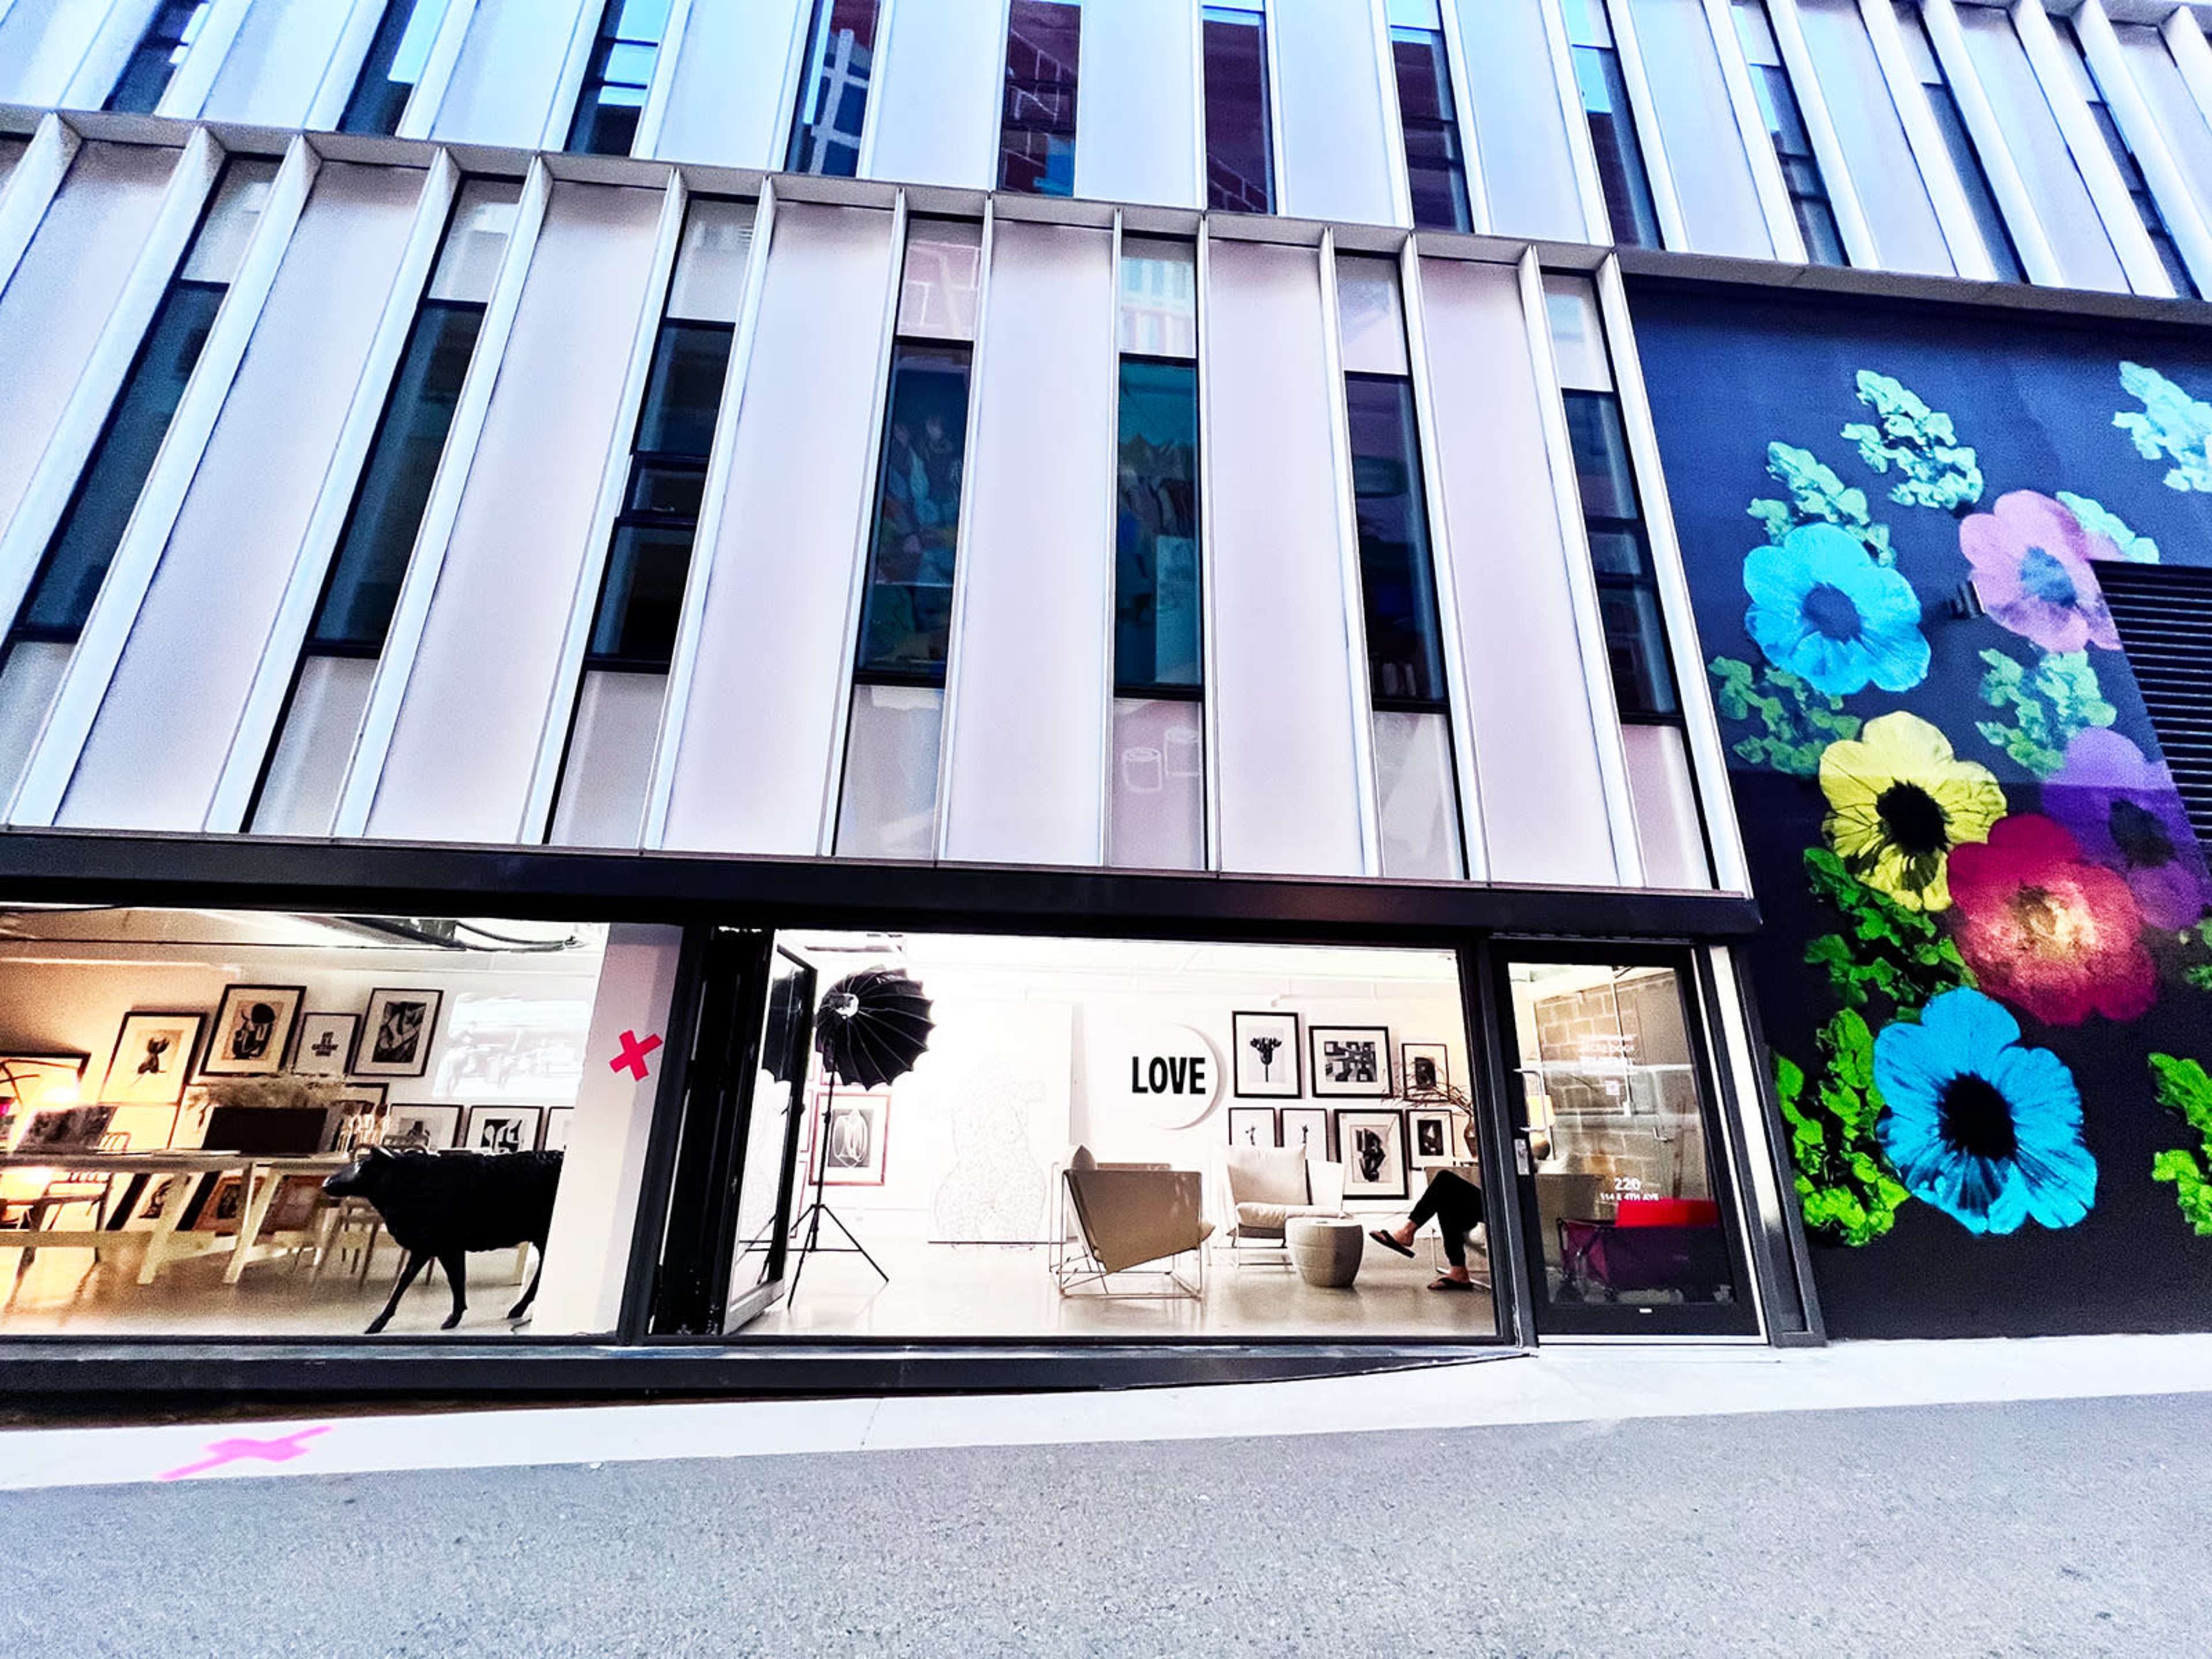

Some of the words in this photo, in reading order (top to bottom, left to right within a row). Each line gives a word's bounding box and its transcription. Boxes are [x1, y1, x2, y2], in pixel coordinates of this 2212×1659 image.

[1132, 1056, 1206, 1094] LOVE
[1615, 1177, 1641, 1191] 220
[1642, 1193, 1659, 1201] AVE
